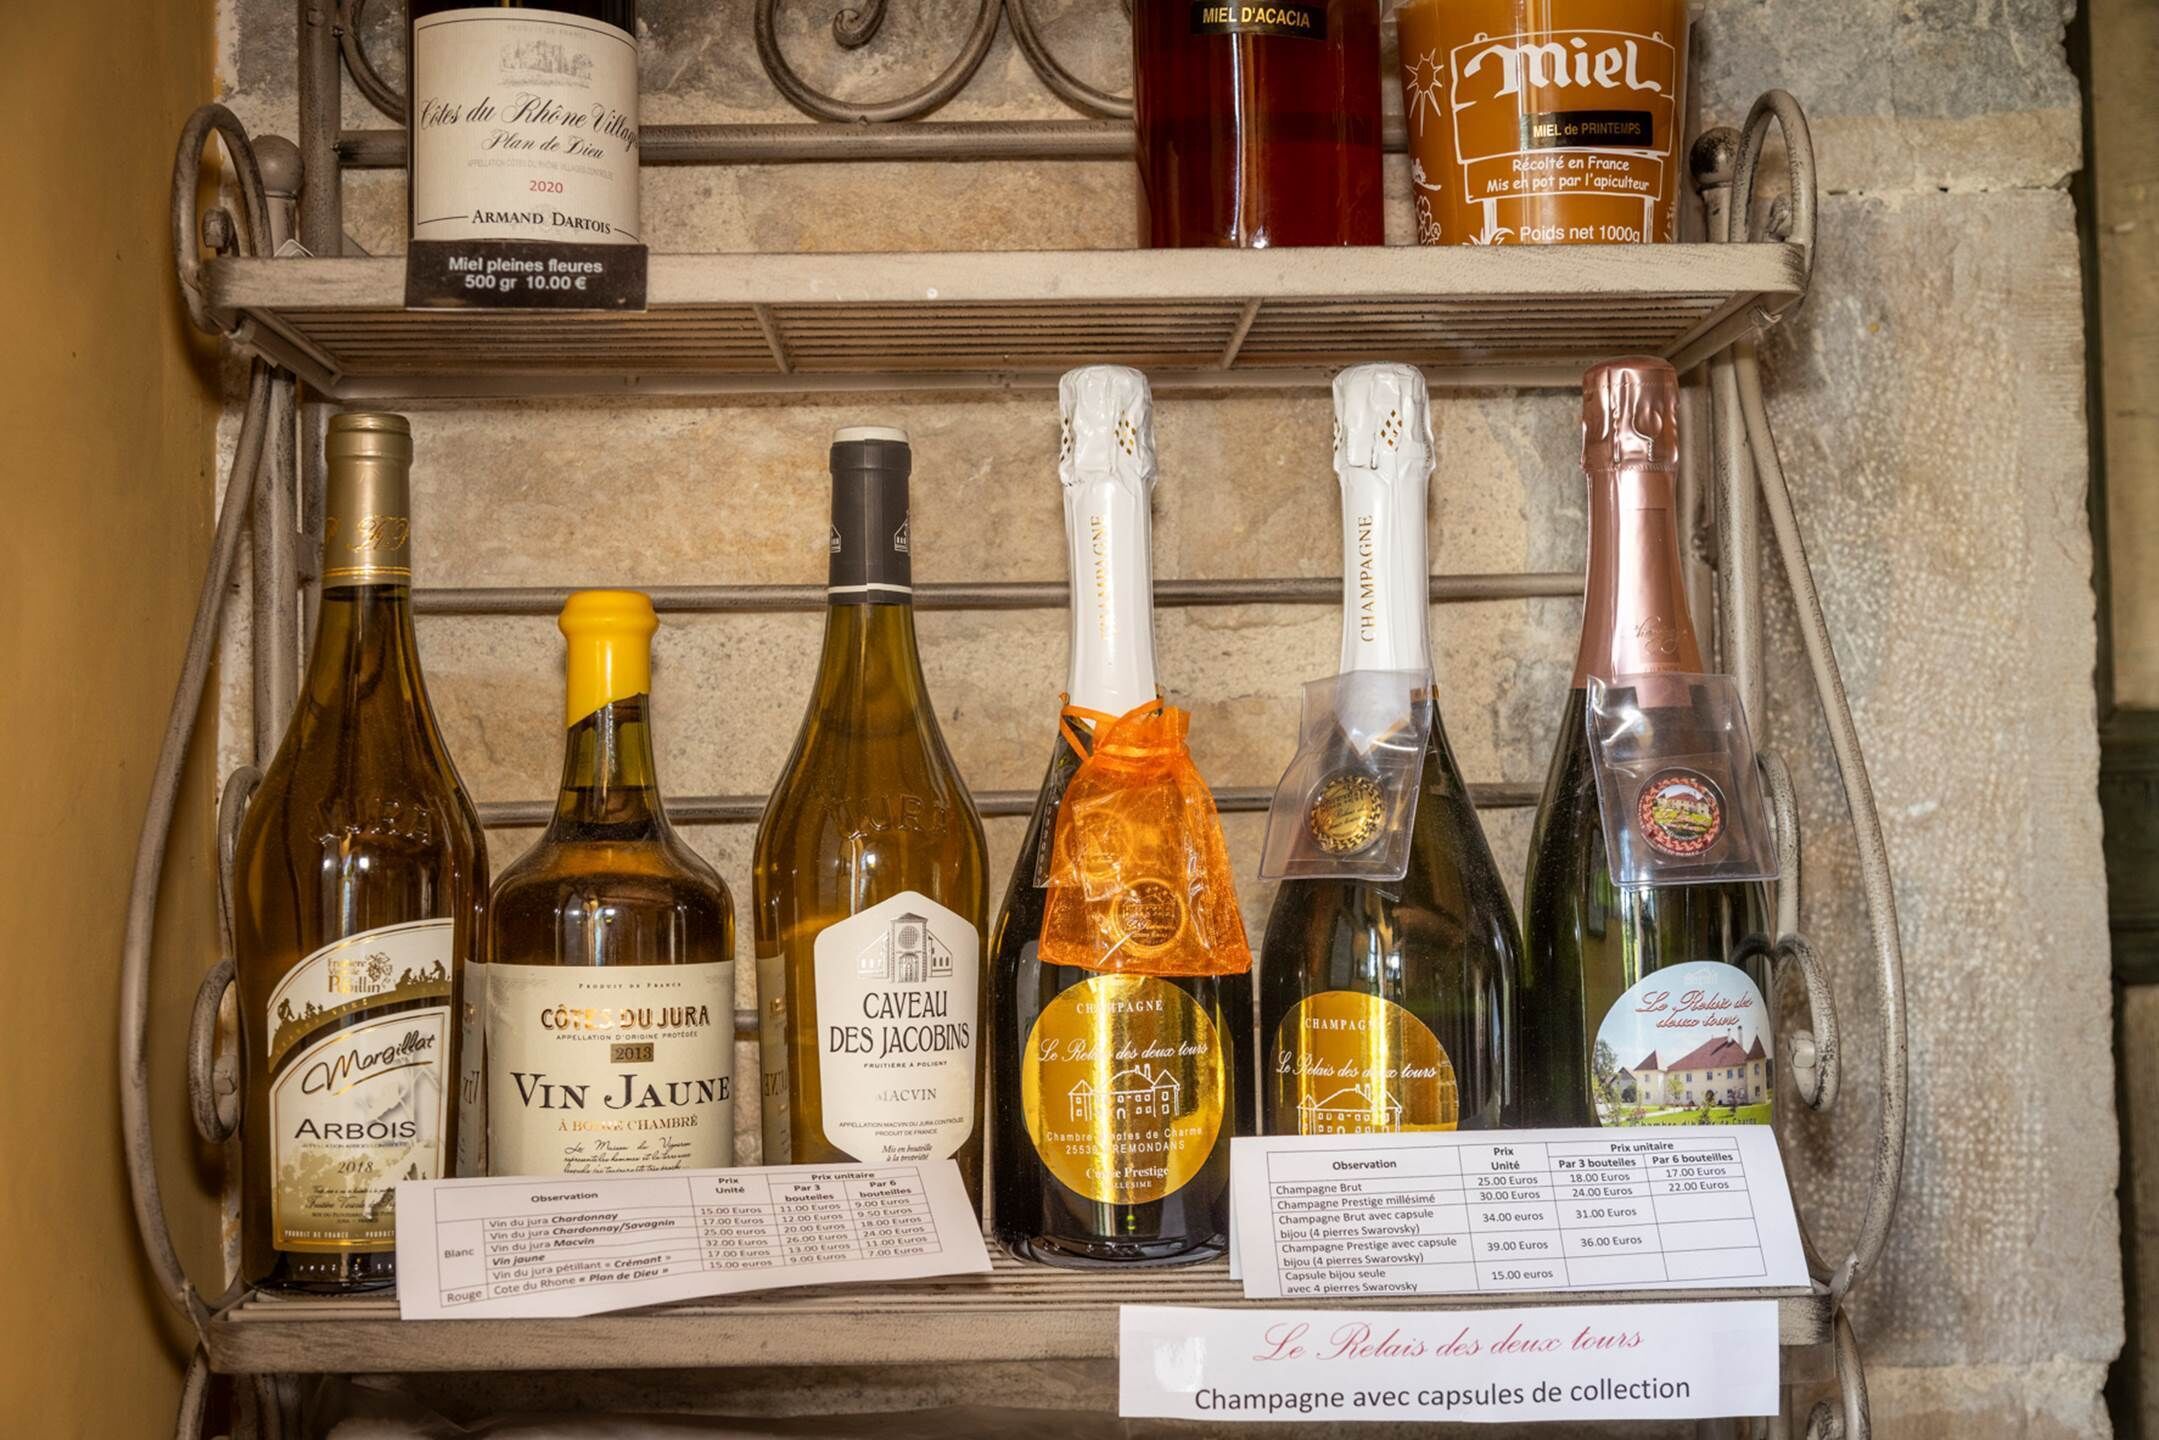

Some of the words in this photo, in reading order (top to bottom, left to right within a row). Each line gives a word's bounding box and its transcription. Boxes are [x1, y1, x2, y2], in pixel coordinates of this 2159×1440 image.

[1203, 7, 1237, 23] MIEL
[1241, 7, 1310, 28] D'ACACIA
[420, 97, 462, 130] Côtes
[466, 96, 496, 122] du
[502, 92, 586, 128] Rhône
[1533, 124, 1561, 138] MIEL
[1564, 124, 1578, 136] de
[1581, 122, 1641, 135] PRINTEMPS
[481, 129, 539, 151] Plan
[540, 136, 558, 151] de
[561, 135, 605, 159] Dieu
[1513, 156, 1564, 172] Récolté
[1568, 159, 1585, 169] en
[1588, 156, 1630, 171] France
[530, 180, 563, 193] 2020
[1487, 179, 1509, 193] Mis
[1513, 179, 1528, 190] en
[1532, 176, 1555, 192] pot
[1558, 176, 1581, 191] par
[1585, 173, 1650, 191] l'apiculteur
[472, 210, 544, 225] ARMAND
[552, 212, 611, 234] DARTOIS
[1520, 226, 1565, 242] Poids
[1569, 227, 1595, 240] net
[1599, 225, 1641, 243] 1000g
[449, 257, 482, 271] Miel
[487, 258, 544, 274] pleines
[548, 259, 603, 273] fleures
[465, 275, 495, 289] 500
[500, 278, 517, 292] gr
[526, 276, 571, 290] 10.00
[575, 277, 587, 290] €
[1358, 515, 1374, 643] CHAMPAGNE
[863, 991, 947, 1019] CAVEAU
[1077, 1000, 1163, 1014] CHMPAGNE
[1635, 991, 1670, 1012] Le
[620, 1007, 652, 1029] DU
[657, 1005, 710, 1028] JURA
[662, 1030, 699, 1039] PROTÉGÉE
[830, 1026, 873, 1053] DES
[880, 1022, 970, 1059] JACOBINS
[1039, 1038, 1060, 1061] Le
[1116, 1040, 1137, 1060] des
[1142, 1040, 1175, 1059] deux
[1178, 1040, 1208, 1056] tours
[1276, 1051, 1292, 1073] Le
[1292, 1054, 1334, 1076] Relais
[1338, 1059, 1359, 1077] des
[1401, 1063, 1437, 1078] tours
[510, 1072, 591, 1110] VIN
[603, 1073, 731, 1110] JAUNE
[294, 1118, 417, 1140] ARBOIS
[627, 1114, 699, 1131] CHAMBRÉ
[1146, 1130, 1158, 1139] de
[1493, 1147, 1514, 1156] Prix
[1610, 1142, 1631, 1153] Prix
[1633, 1141, 1674, 1152] unitaire
[1332, 1160, 1397, 1171] Observation
[1491, 1160, 1520, 1171] Unité
[1558, 1159, 1575, 1168] Par
[1578, 1158, 1585, 1168] 3
[1652, 1155, 1670, 1165] Par
[1672, 1154, 1679, 1164] 6
[1681, 1152, 1734, 1164] bouteilles
[337, 1161, 374, 1175] 2018
[1125, 1166, 1169, 1179] Prestige
[1666, 1167, 1695, 1177] 17.00
[1697, 1166, 1726, 1176] Euros
[1477, 1176, 1506, 1186] 25.00
[1508, 1174, 1538, 1185] Euros
[1570, 1173, 1599, 1182] 18.00
[1601, 1171, 1630, 1181] Euros
[1276, 1184, 1337, 1196] Champagne
[1340, 1183, 1362, 1192] Brut
[1572, 1188, 1601, 1197] 24.00
[1603, 1186, 1632, 1196] Euros
[1668, 1182, 1698, 1192] 22.00
[1700, 1180, 1729, 1190] Euros
[531, 1192, 598, 1203] Observation
[1277, 1200, 1339, 1211] Champagne
[1341, 1197, 1383, 1208] Prestige
[1386, 1194, 1436, 1205] millésimé
[1480, 1191, 1509, 1201] 30.00
[1511, 1190, 1541, 1200] Euros
[489, 1219, 509, 1228] Vin
[510, 1218, 524, 1227] du
[527, 1217, 549, 1227] jura
[552, 1212, 618, 1224] Chardonnay
[1279, 1214, 1341, 1227] Champagne
[1343, 1212, 1366, 1222] Brut
[1369, 1213, 1392, 1221] avec
[1395, 1209, 1434, 1221] capsule
[1483, 1212, 1512, 1223] 34.00
[1515, 1211, 1544, 1221] euros
[1576, 1209, 1605, 1218] 31.00
[1607, 1207, 1637, 1217] Euros
[490, 1231, 509, 1240] Vin
[511, 1230, 525, 1239] du
[527, 1229, 549, 1239] jura
[552, 1219, 675, 1236] Chardonnay/Savagnin
[1280, 1229, 1308, 1240] bijou
[1310, 1228, 1321, 1238] (4
[1323, 1227, 1359, 1238] pierres
[1361, 1224, 1420, 1235] Swarovsky)
[491, 1243, 510, 1252] Vin
[512, 1242, 526, 1251] du
[528, 1241, 551, 1252] jura
[554, 1237, 595, 1247] Macvin
[444, 1248, 474, 1258] Blanc
[493, 1256, 511, 1266] Vin
[513, 1254, 545, 1267] jaune
[1286, 1271, 1327, 1283] Capsule
[1329, 1270, 1355, 1280] bijou
[1359, 1268, 1386, 1279] seule
[447, 1290, 482, 1303] Rouge
[1252, 1322, 1310, 1362] Le
[1316, 1321, 1428, 1361] Relais
[1434, 1326, 1482, 1357] des
[1490, 1323, 1562, 1356] deux
[1570, 1325, 1645, 1351] tours
[1195, 1388, 1345, 1413] Champagne
[1353, 1389, 1410, 1407] avec
[1418, 1382, 1524, 1411] capsules
[1531, 1381, 1562, 1402] de
[1570, 1378, 1691, 1401] collection
